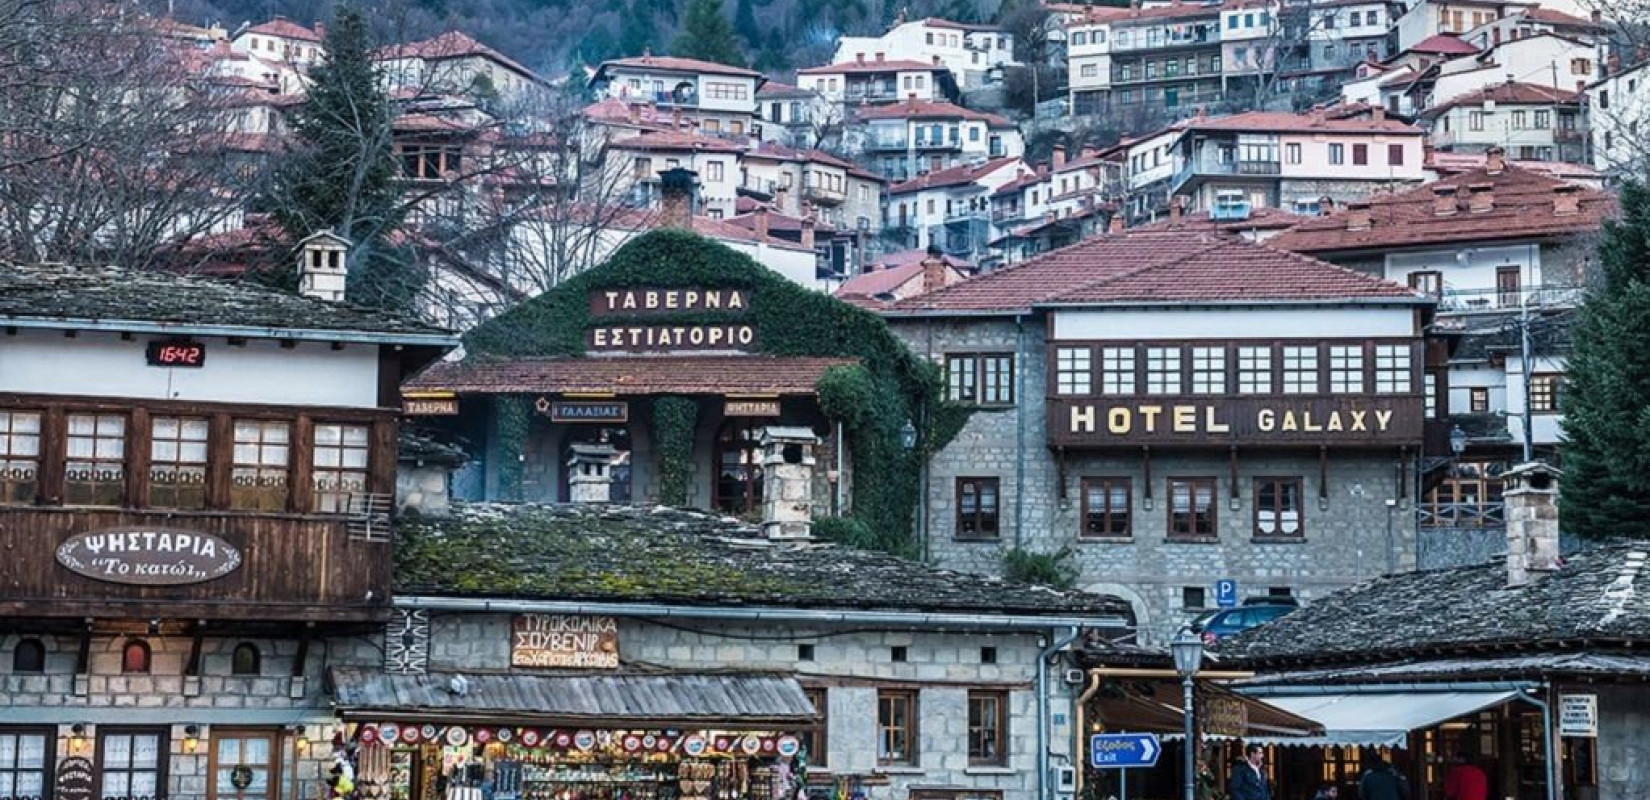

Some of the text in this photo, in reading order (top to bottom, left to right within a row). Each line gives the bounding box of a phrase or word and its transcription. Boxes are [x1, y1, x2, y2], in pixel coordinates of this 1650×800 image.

[605, 291, 742, 309] ΤΑΒΕΡΝΑ
[593, 326, 754, 346] ΕΣΤΙΑΤΟΡΙΟ
[1070, 405, 1393, 434] HOTEL GALAXY
[84, 531, 216, 558] ΨΗΣΤΑΡΙΑ
[1221, 581, 1232, 598] P
[514, 631, 599, 651] ΣΟΥΒΕΝΙΡ
[1095, 751, 1117, 763] Exit
